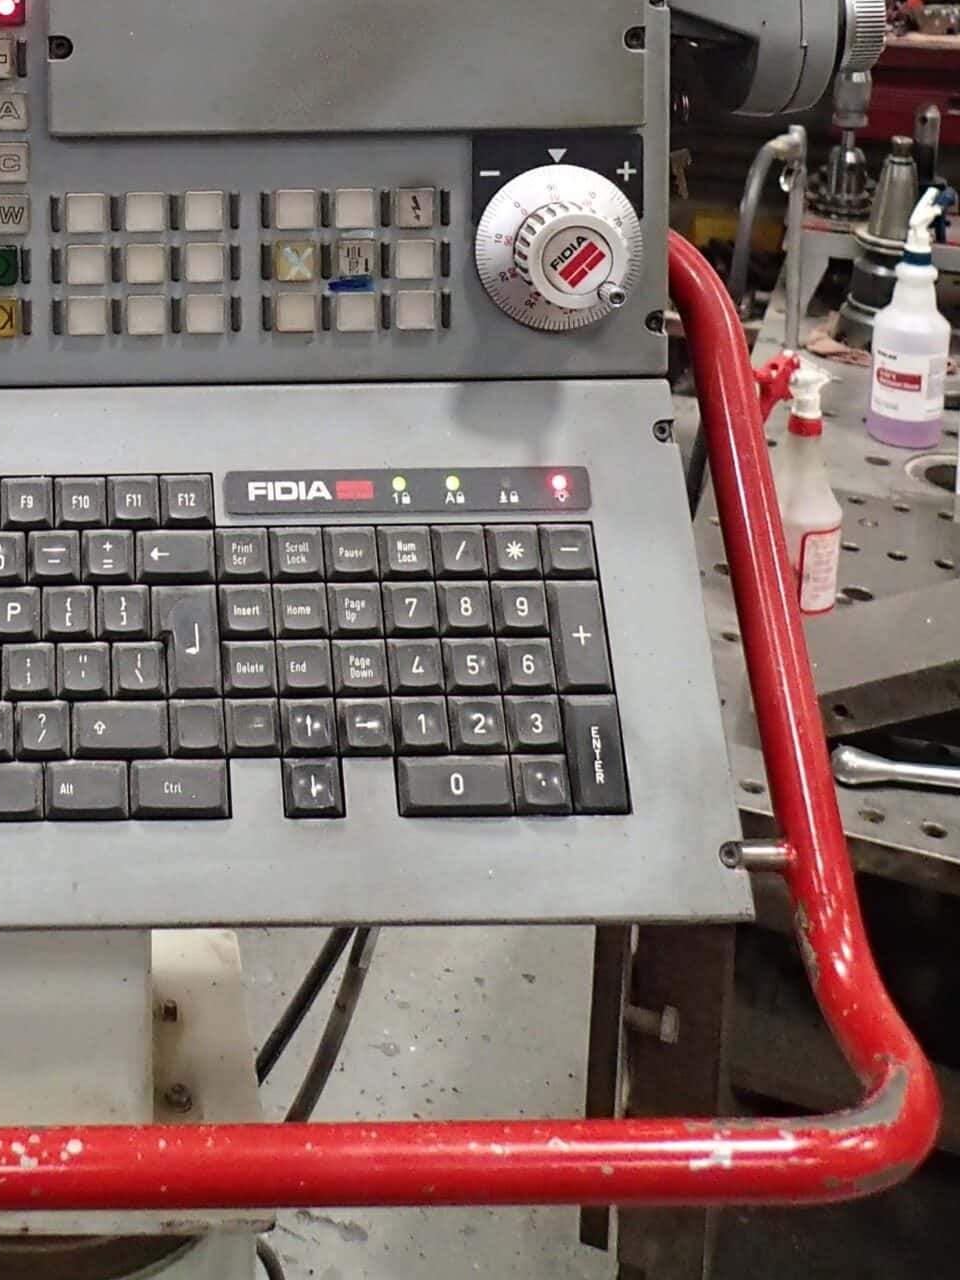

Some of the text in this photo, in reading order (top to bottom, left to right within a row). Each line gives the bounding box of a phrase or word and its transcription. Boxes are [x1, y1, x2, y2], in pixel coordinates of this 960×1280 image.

[0, 154, 20, 172] C
[0, 206, 24, 224] W
[551, 236, 588, 270] FIDIA
[248, 480, 332, 501] FIDIA
[21, 495, 33, 508] F9
[72, 495, 89, 508] F10
[126, 494, 141, 506] F11
[178, 493, 195, 506] F12
[8, 603, 20, 621] P
[234, 605, 260, 616] Insert
[291, 661, 306, 672] End
[591, 726, 605, 783] ENTER
